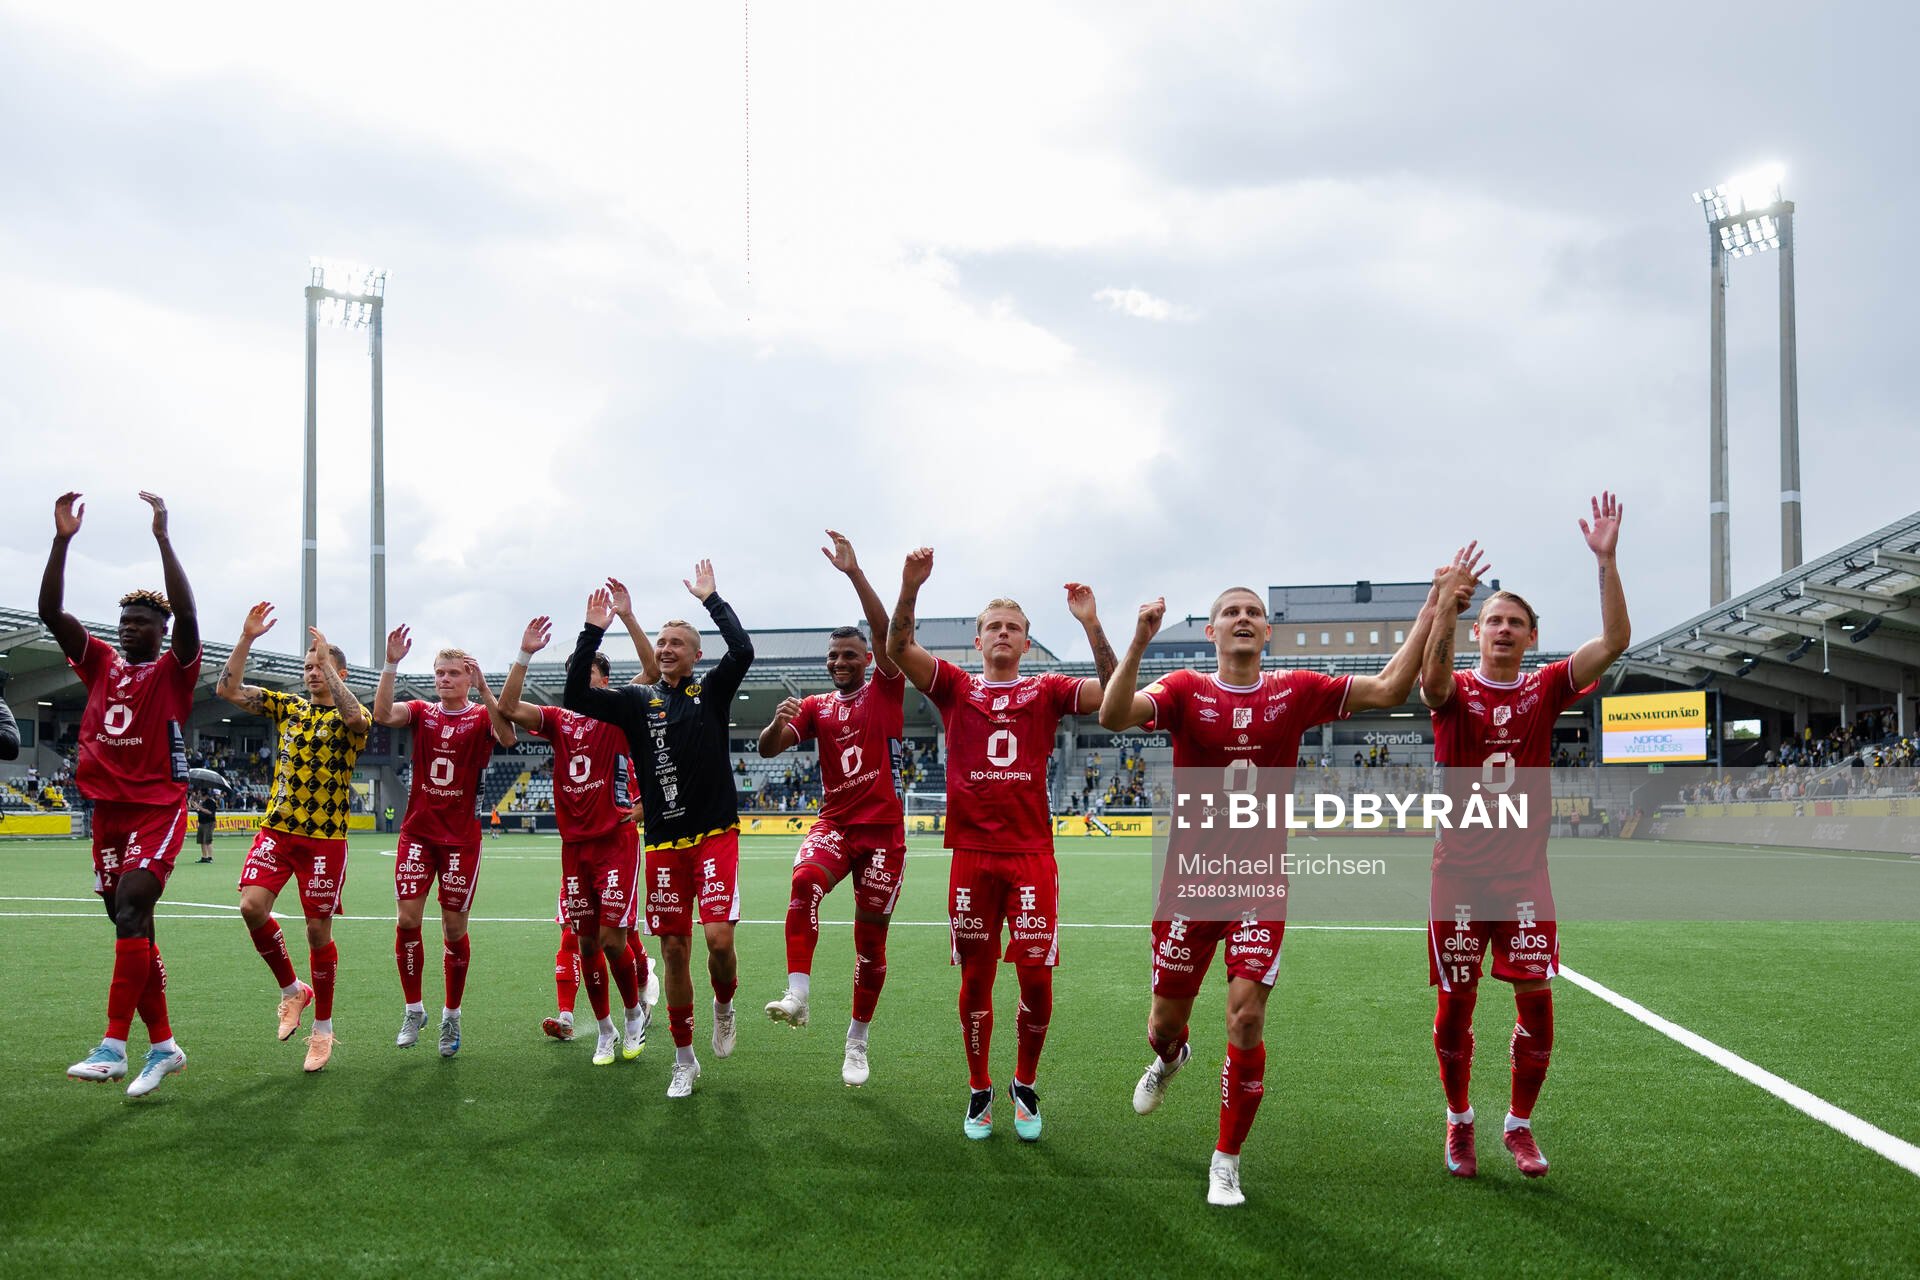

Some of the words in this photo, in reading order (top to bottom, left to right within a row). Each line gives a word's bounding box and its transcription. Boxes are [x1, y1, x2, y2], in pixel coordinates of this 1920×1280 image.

[1608, 712, 1640, 721] DAGENS
[1642, 706, 1699, 720] MATCHVÄRD
[1376, 732, 1422, 744] bravida
[1634, 734, 1672, 744] NORDIC
[1624, 744, 1682, 753] WELLNESS
[970, 771, 1032, 780] RO-GRUPPEN
[220, 817, 250, 830] KÄMPAR
[1088, 822, 1141, 831] Sdium
[806, 848, 814, 858] 5
[398, 860, 424, 872] ellos
[244, 868, 258, 880] 18
[442, 872, 466, 885] ellos
[864, 868, 891, 882] ellos
[308, 876, 334, 888] ellos
[400, 882, 417, 894] 25
[866, 880, 894, 893] Skrotfrag
[602, 887, 624, 900] ellos
[650, 888, 679, 903] ellos
[655, 905, 682, 914] Skrotfrag
[810, 894, 818, 931] PAROY
[652, 914, 660, 928] 8
[952, 912, 983, 930] ellos
[1016, 912, 1046, 928] ellos
[956, 932, 989, 940] Skrotfrag
[1020, 932, 1052, 940] Skrotfrag
[1232, 927, 1270, 942] ellos
[1444, 932, 1479, 950] ellos
[1510, 930, 1548, 950] ellos
[1159, 938, 1190, 960] ellos
[1238, 945, 1272, 958] Skrotfrag
[406, 948, 415, 976] PAROY
[1454, 954, 1480, 963] Skrofrg
[1516, 952, 1552, 962] Skrotfrag
[1159, 958, 1194, 974] Skrotfrag
[1450, 966, 1470, 982] 15
[972, 1021, 980, 1056] PAROY
[1222, 1056, 1231, 1110] PAROY
